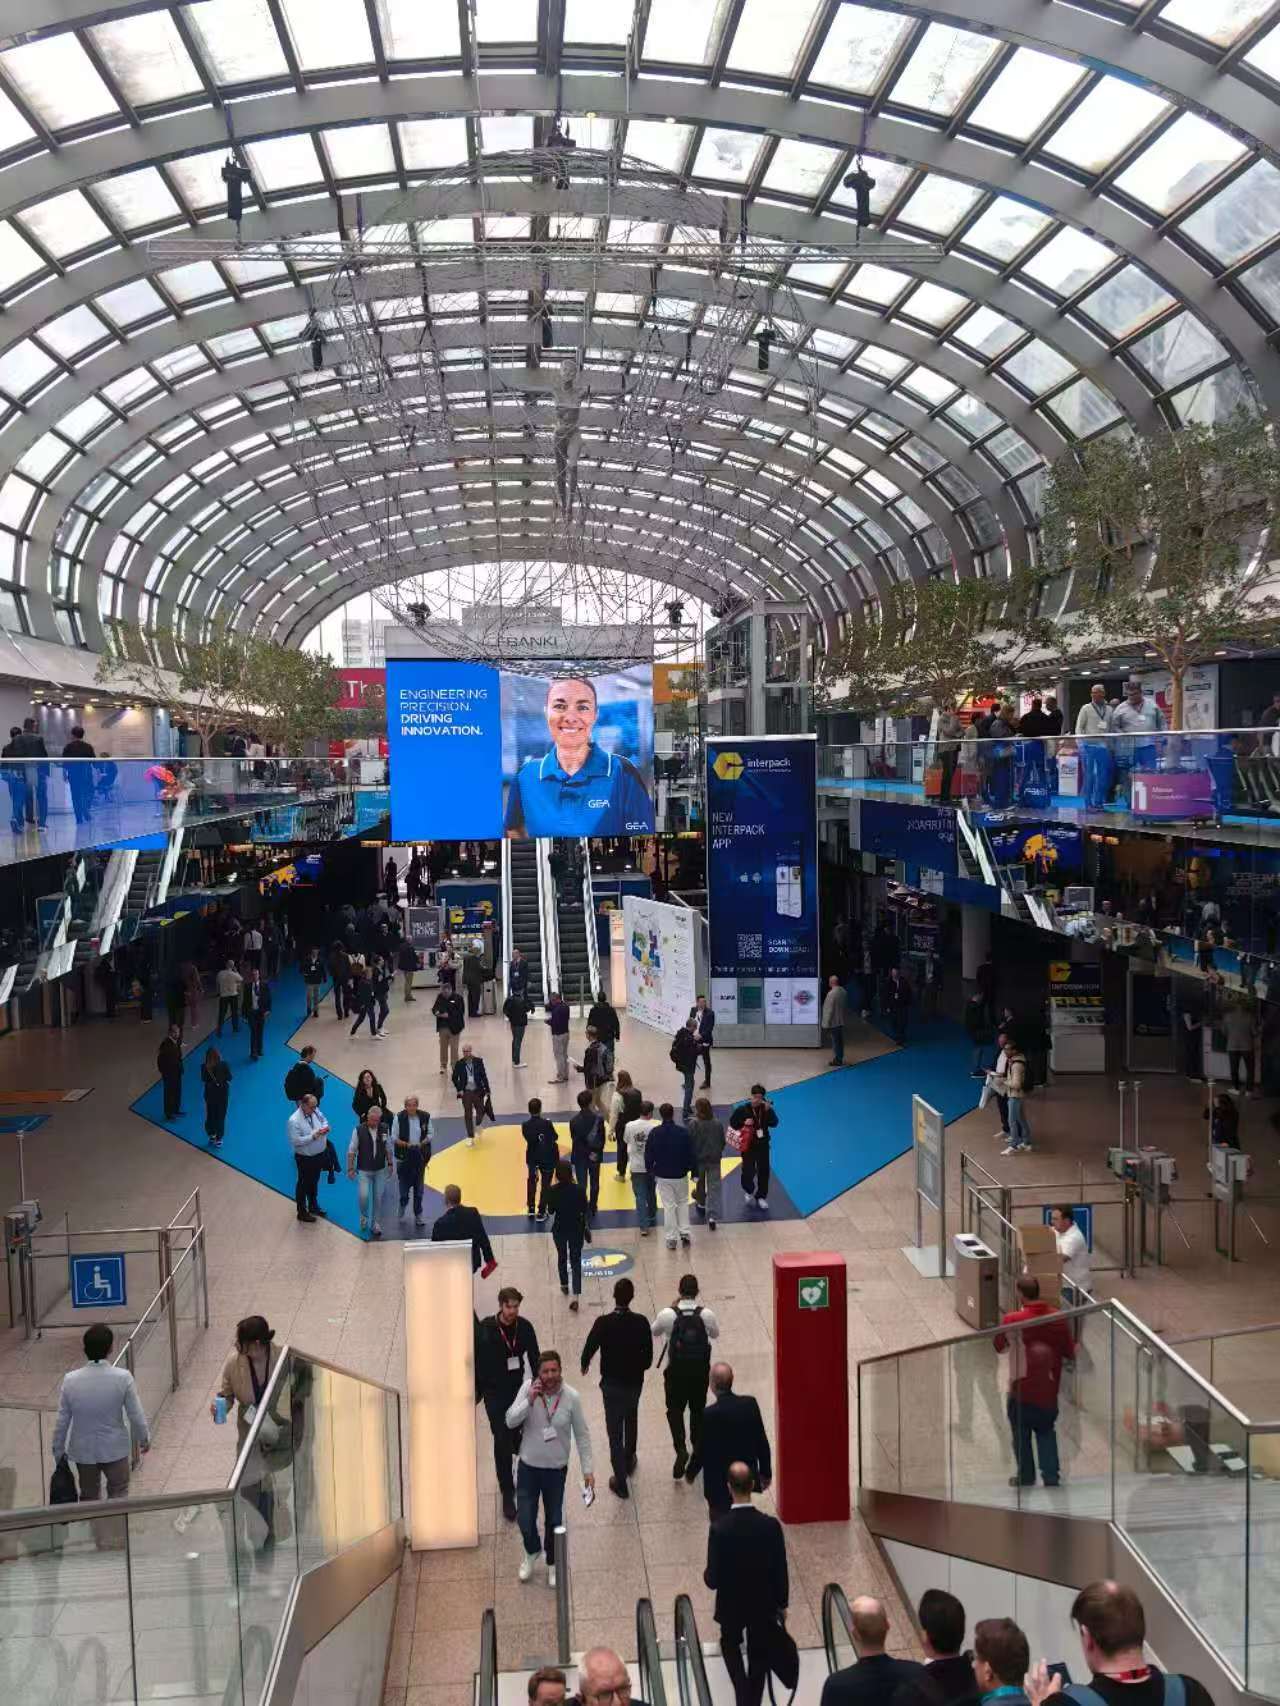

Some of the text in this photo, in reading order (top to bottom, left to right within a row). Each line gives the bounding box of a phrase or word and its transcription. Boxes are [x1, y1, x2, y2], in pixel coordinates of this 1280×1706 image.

[400, 690, 488, 699] ENGINEERING
[400, 702, 472, 712] PRECISION.
[401, 714, 453, 723] DRIVING
[401, 726, 483, 736] INNOVATION.
[747, 758, 791, 769] interpack
[588, 799, 610, 809] GEA
[712, 812, 733, 823] NEW
[625, 821, 649, 830] GEA
[712, 825, 765, 836] INTERPACK
[712, 839, 732, 849] APP
